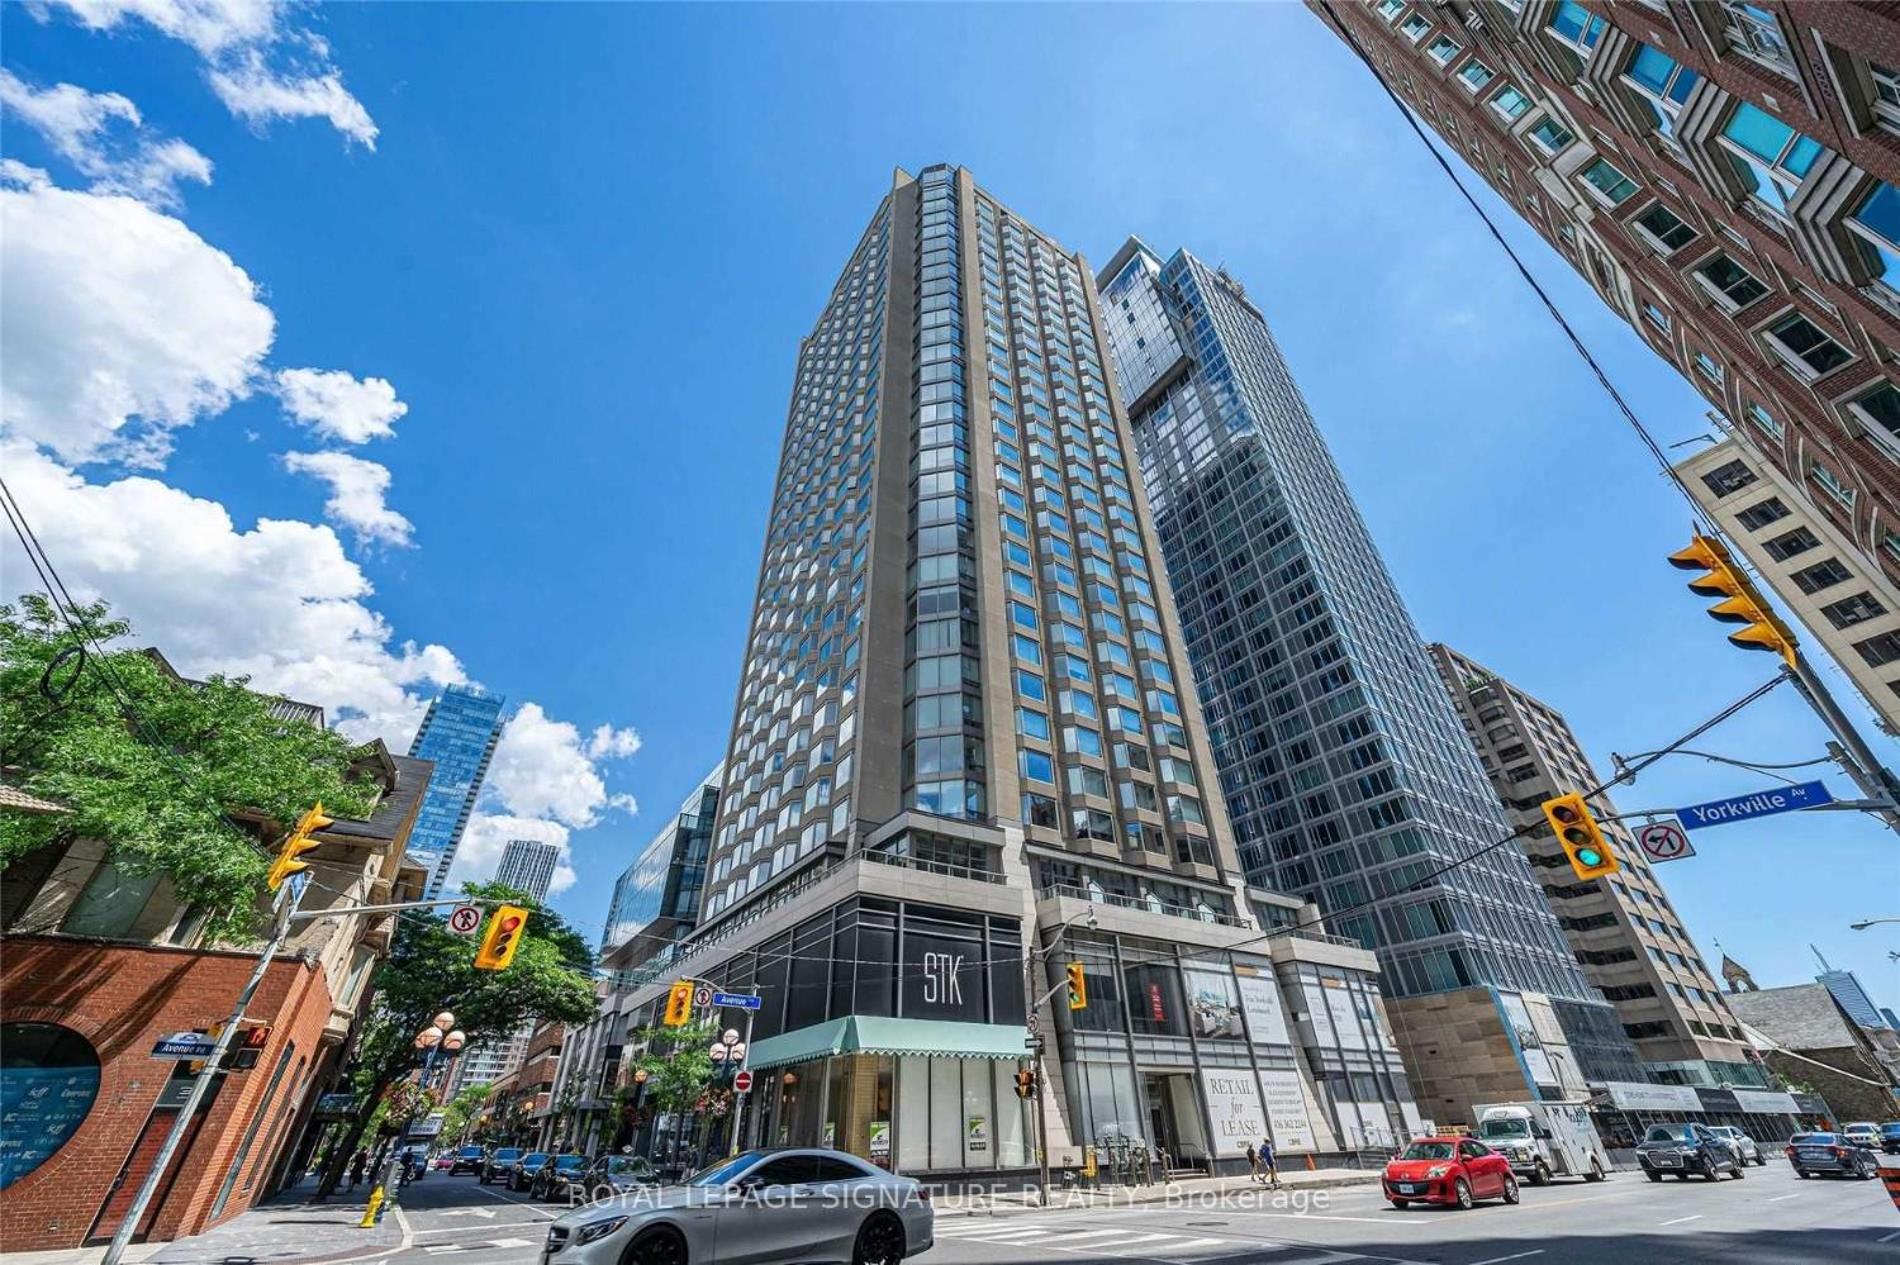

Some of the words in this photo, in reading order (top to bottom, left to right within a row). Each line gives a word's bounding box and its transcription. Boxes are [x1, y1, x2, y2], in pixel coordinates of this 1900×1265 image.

[1692, 794, 1786, 822] Yorkville
[924, 952, 963, 1005] STK
[161, 1043, 194, 1054] Avenue
[1210, 1078, 1255, 1095] RETAIL
[1230, 1096, 1244, 1118] for
[1221, 1120, 1261, 1137] LEASE
